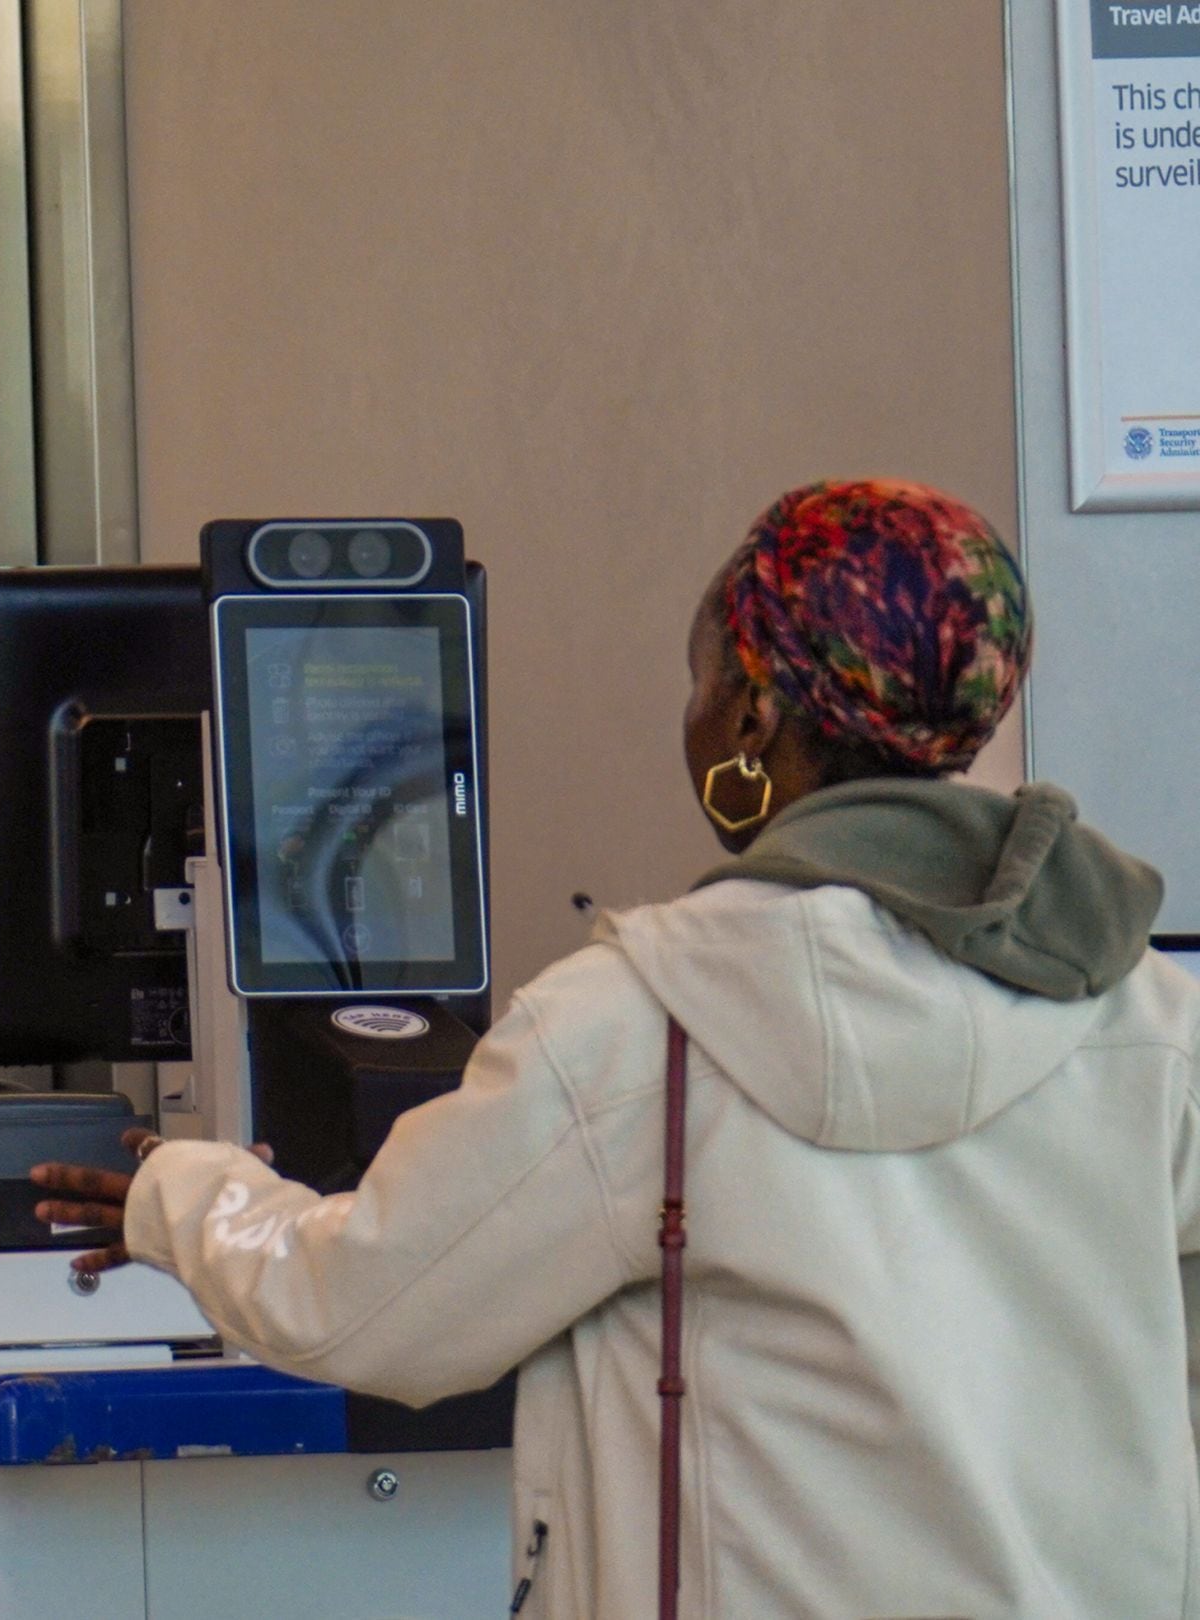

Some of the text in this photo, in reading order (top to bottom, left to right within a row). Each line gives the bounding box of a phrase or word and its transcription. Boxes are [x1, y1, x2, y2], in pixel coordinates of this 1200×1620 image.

[1109, 5, 1171, 25] Travel
[1112, 82, 1200, 110] This ch
[1115, 122, 1135, 149] is
[1160, 438, 1196, 448] Security
[453, 772, 467, 815] mimo
